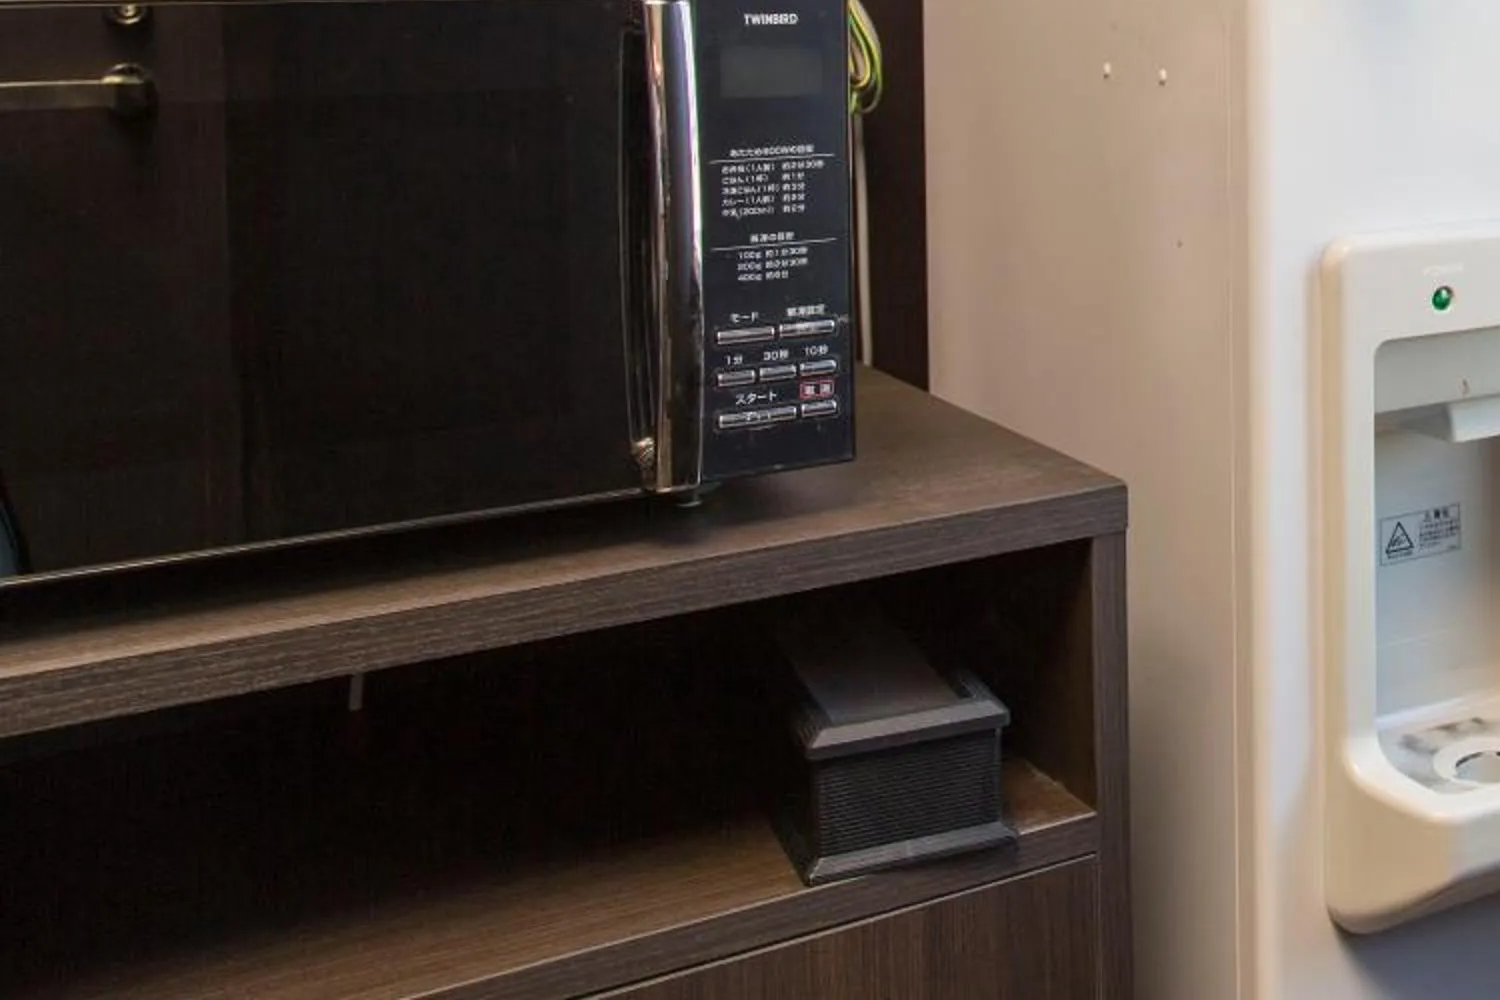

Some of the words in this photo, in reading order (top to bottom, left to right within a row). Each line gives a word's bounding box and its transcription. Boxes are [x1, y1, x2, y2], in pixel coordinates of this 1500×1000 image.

[744, 13, 799, 25] TWINBIRD
[735, 390, 778, 406] スタート
